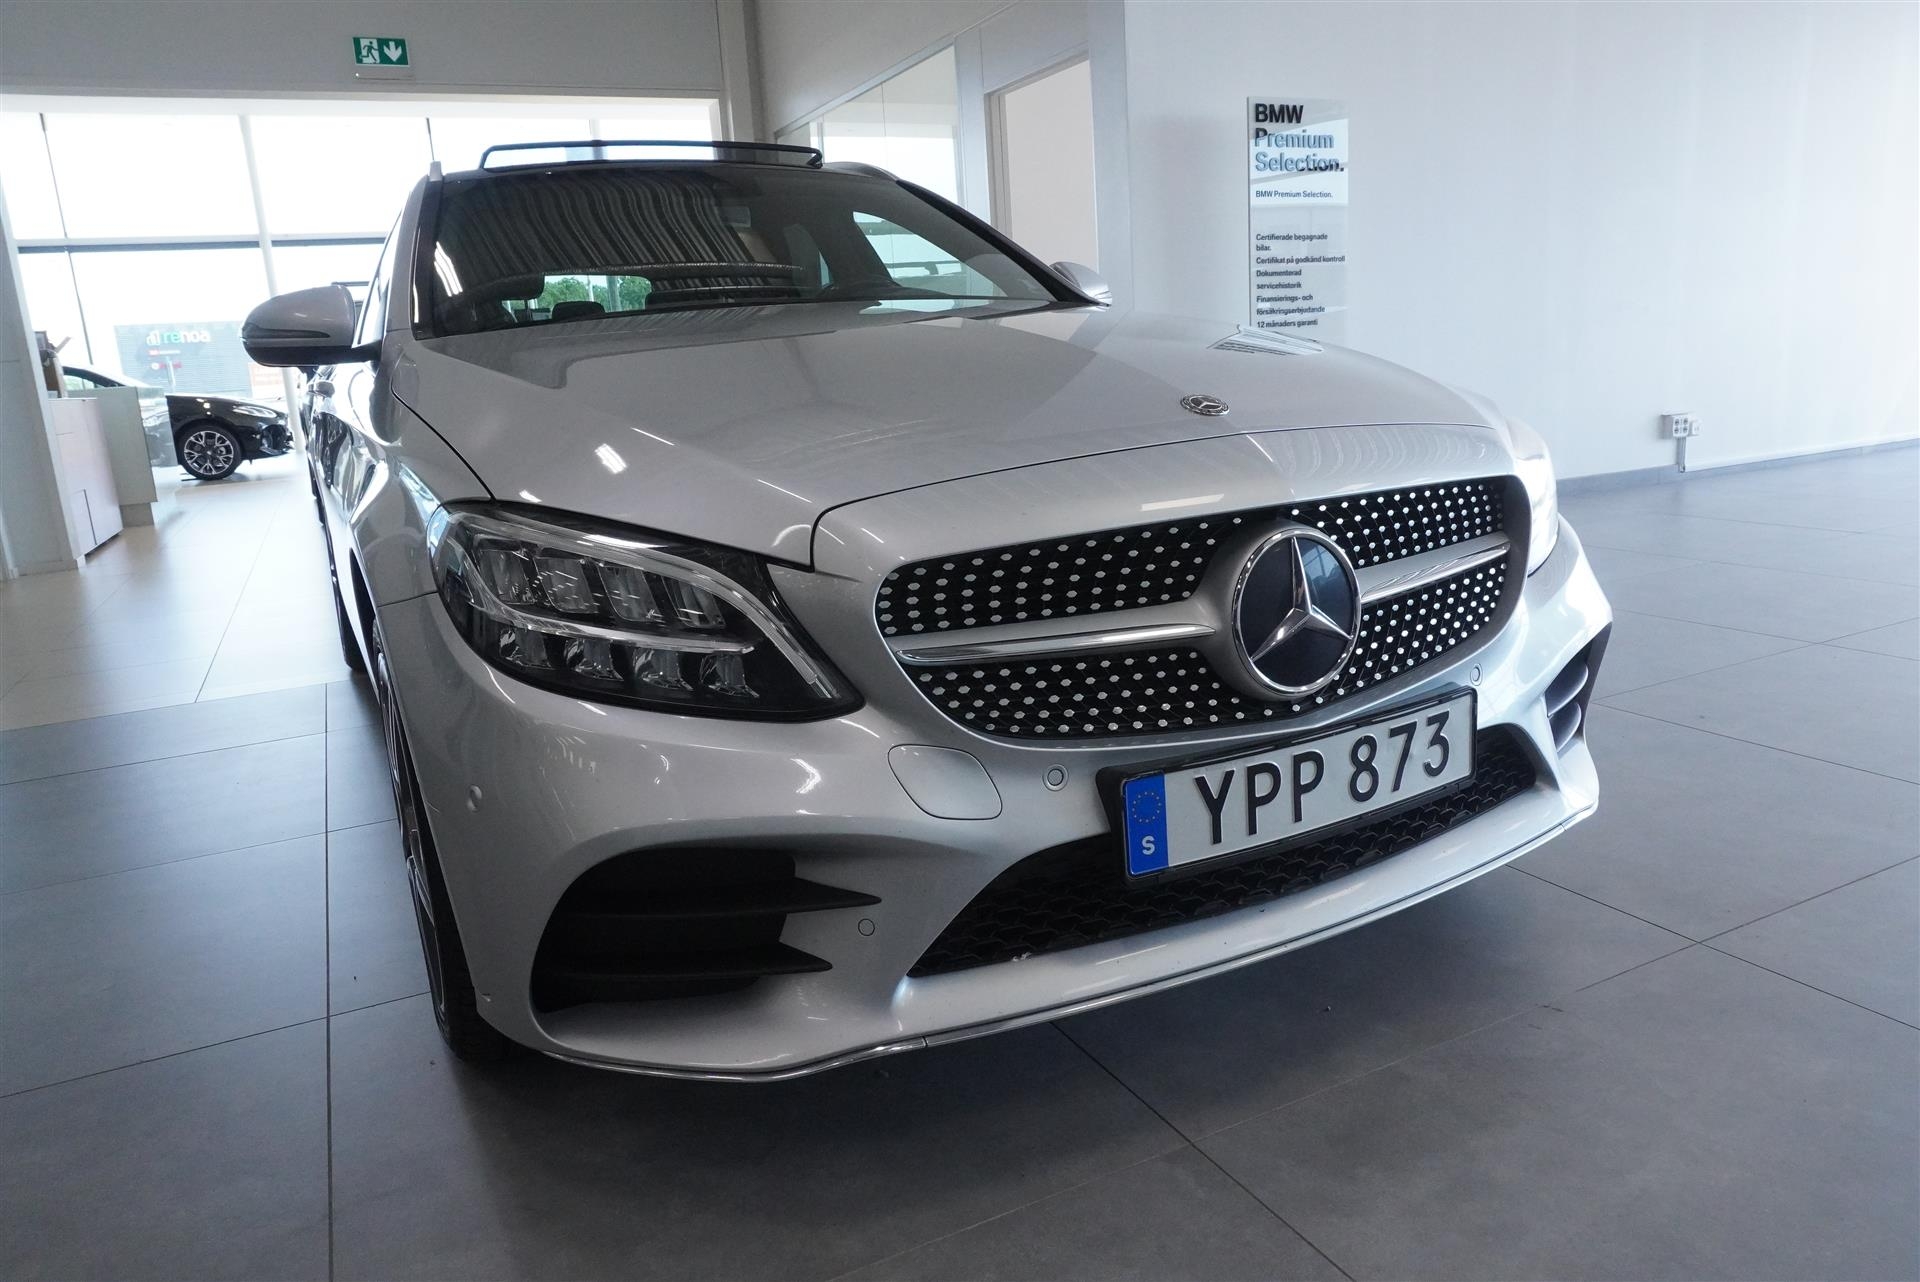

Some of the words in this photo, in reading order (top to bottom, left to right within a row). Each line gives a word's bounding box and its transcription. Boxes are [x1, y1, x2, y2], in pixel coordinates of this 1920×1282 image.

[1255, 103, 1304, 124] BMW
[1254, 127, 1334, 149] Premium
[1255, 151, 1345, 172] Selection.
[1255, 190, 1273, 198] BMW
[1274, 190, 1302, 198] Premium
[1303, 190, 1333, 198] Selection.
[1256, 233, 1293, 241] Certifierade
[1294, 233, 1328, 242] begagnade
[1256, 244, 1272, 252] bilar.
[1256, 257, 1285, 265] Certifikat
[1286, 256, 1294, 265] på
[1295, 256, 1322, 265] godkänd
[1322, 255, 1345, 263] kontroll
[1256, 269, 1302, 277] Dokumenterad
[1256, 281, 1302, 289] servicehistorik
[1256, 295, 1301, 303] Finansierings-
[1257, 321, 1265, 329] 12
[1265, 320, 1296, 329] månaders
[1297, 319, 1318, 328] garanti
[1194, 750, 1325, 845] YPP
[1348, 710, 1451, 802] 873
[1141, 834, 1156, 856] S
